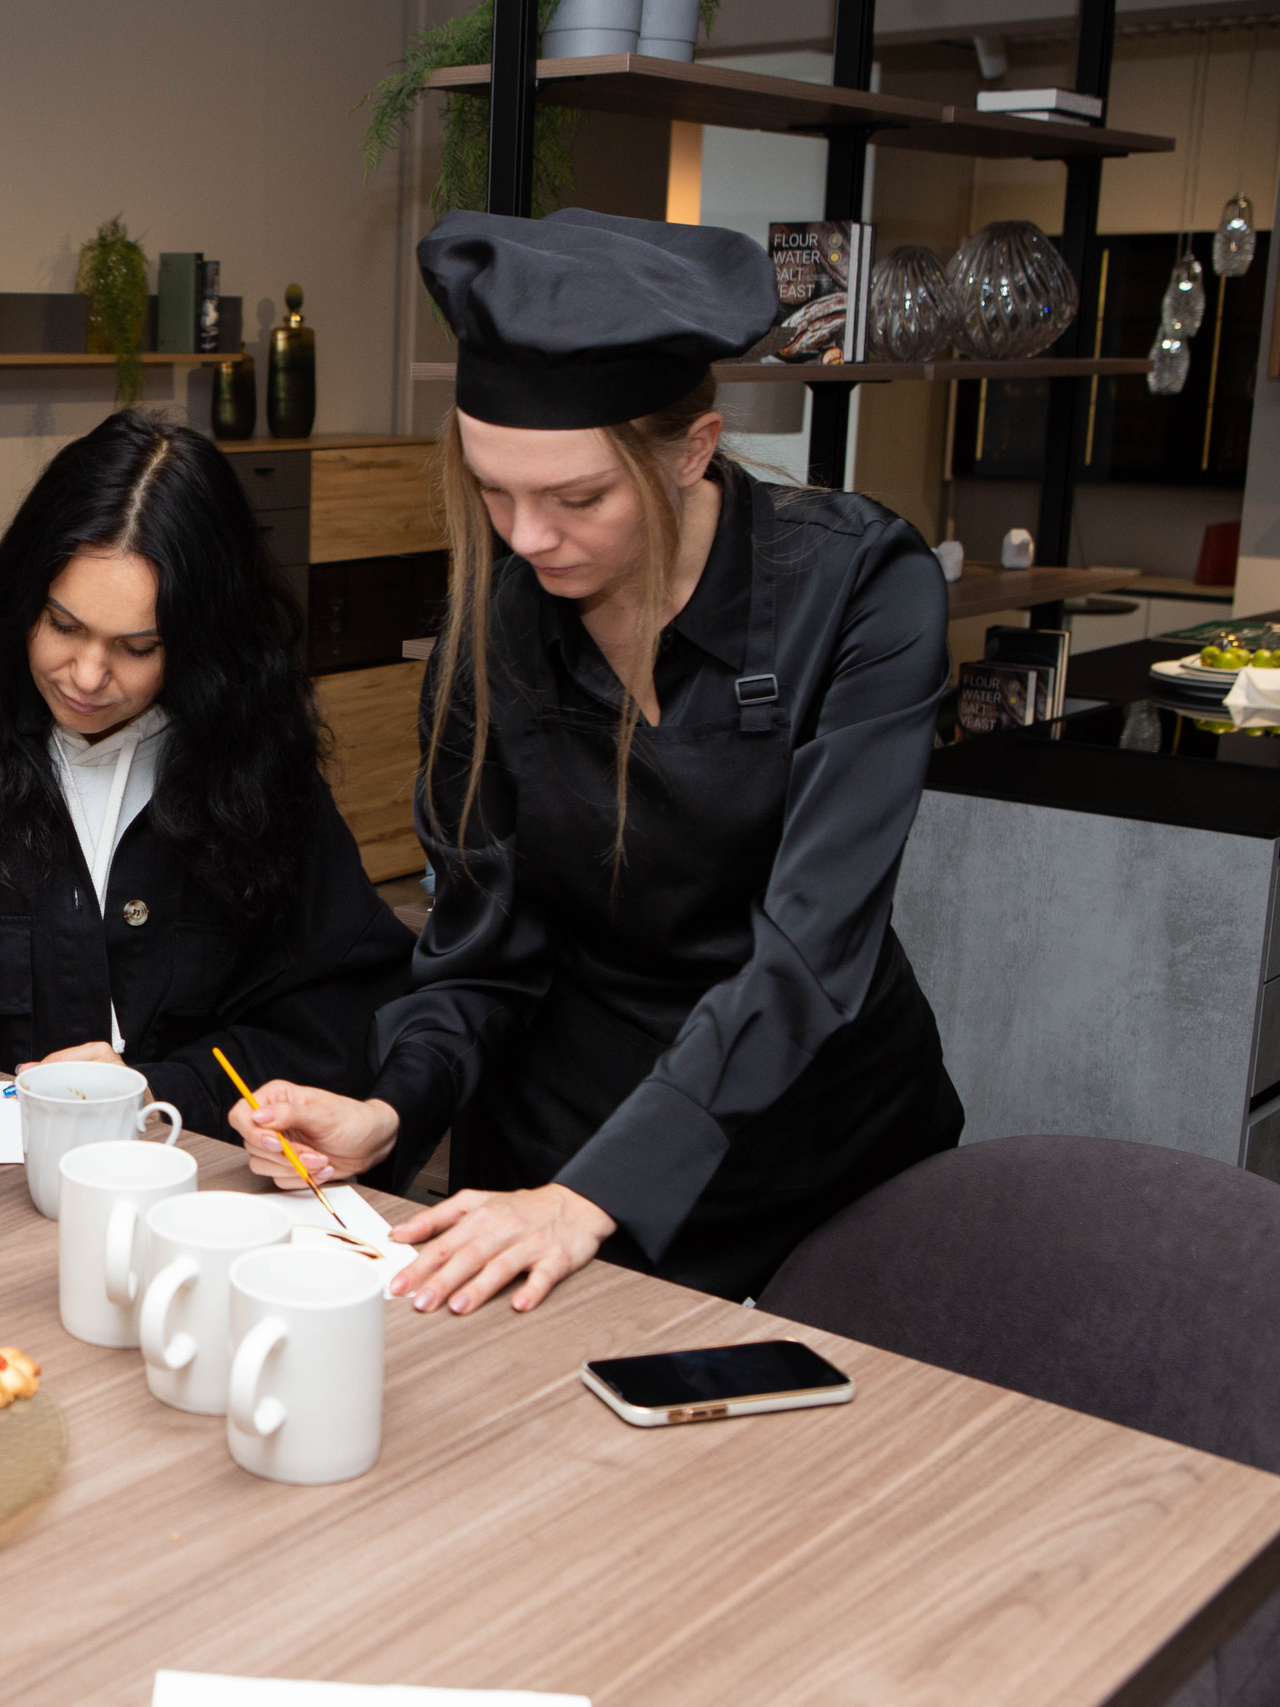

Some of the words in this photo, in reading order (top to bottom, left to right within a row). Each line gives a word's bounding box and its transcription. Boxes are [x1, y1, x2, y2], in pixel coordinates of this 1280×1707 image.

[774, 232, 819, 248] FLOUR
[773, 249, 820, 265] WATER
[778, 284, 815, 298] EAST
[963, 675, 1000, 689] FLOUR
[962, 689, 1002, 703] WATER
[961, 702, 988, 716] SALT
[961, 716, 996, 730] YEAST
